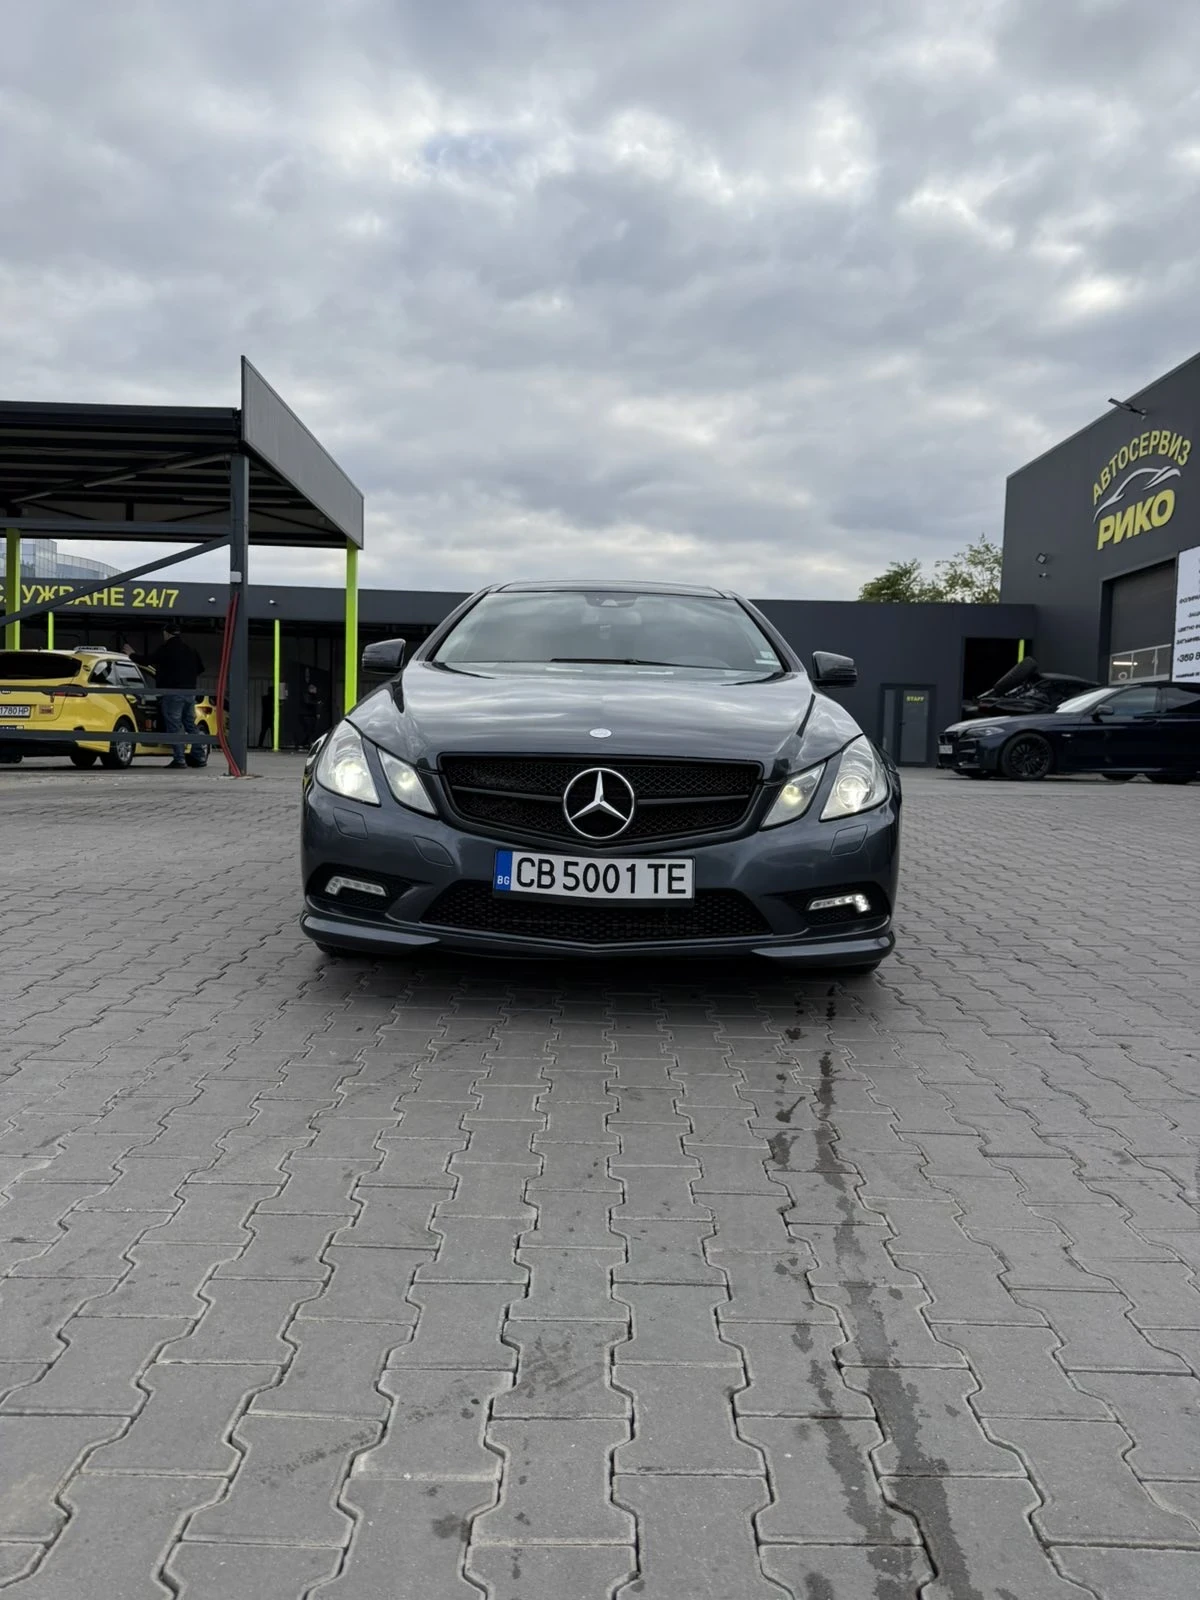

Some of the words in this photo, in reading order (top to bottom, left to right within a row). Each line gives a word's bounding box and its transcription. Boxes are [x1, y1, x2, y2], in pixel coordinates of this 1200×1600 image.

[1092, 429, 1191, 505] АВТОСЕРВИЗ
[1097, 488, 1175, 550] РИКО
[132, 588, 180, 609] 24/7
[497, 875, 510, 885] BG
